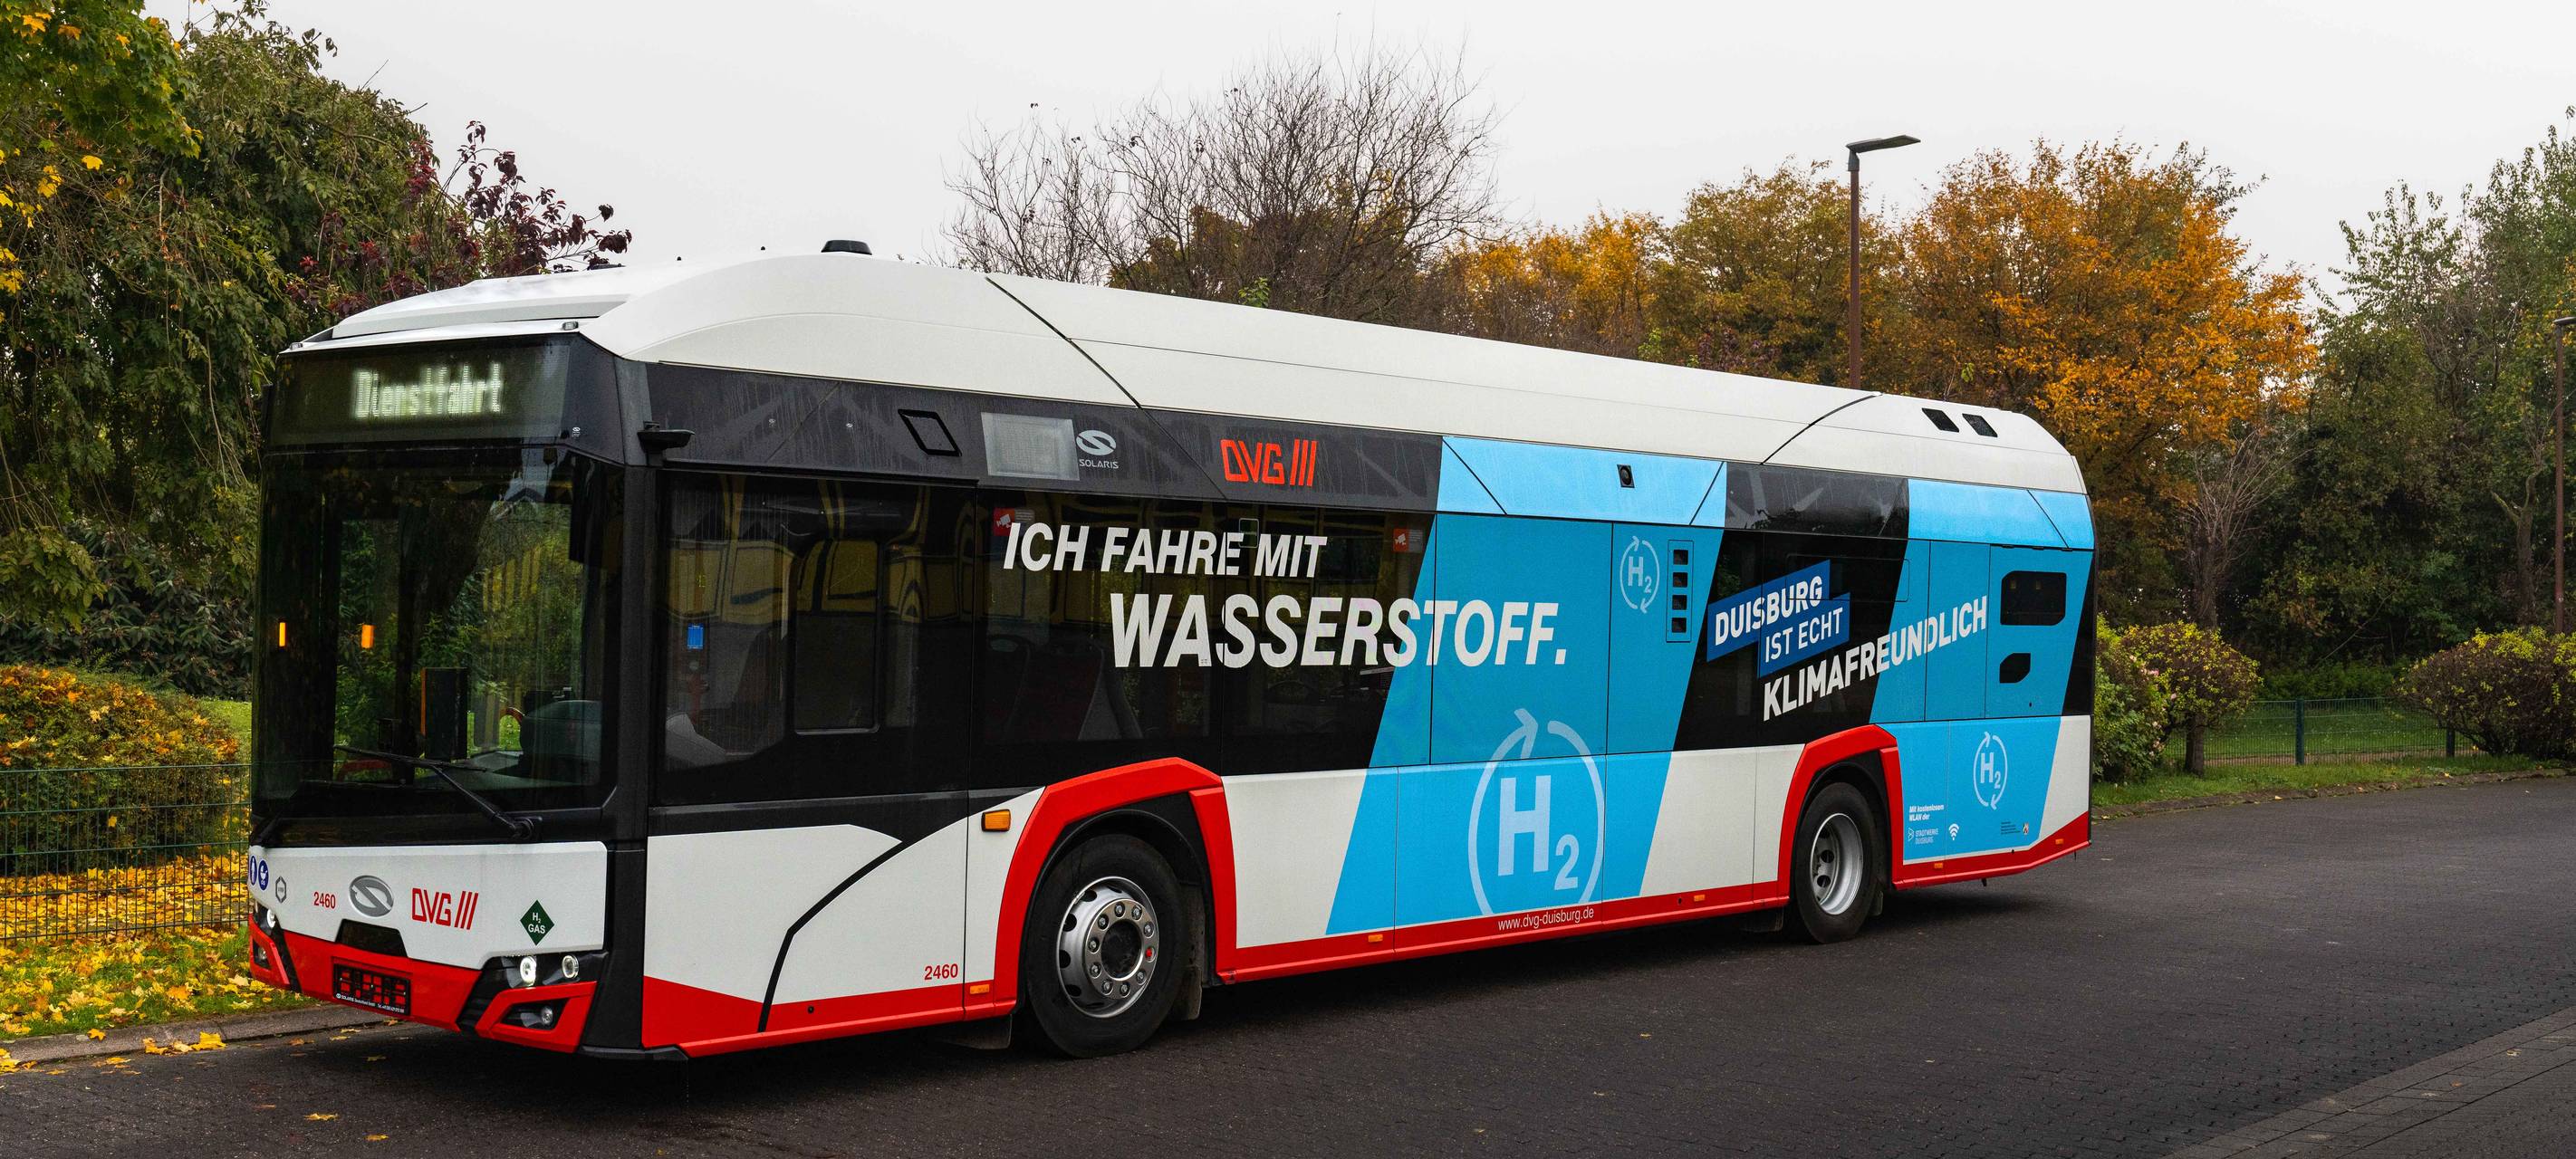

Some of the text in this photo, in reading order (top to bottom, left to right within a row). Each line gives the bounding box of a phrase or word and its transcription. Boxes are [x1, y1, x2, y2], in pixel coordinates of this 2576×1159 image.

[353, 362, 503, 418] Dienstfahrt
[1079, 459, 1119, 469] SOLARIS
[1003, 522, 1328, 579] ICH FAHRE MIT
[1110, 593, 1567, 668] WASSERSTOFF.
[1715, 575, 1822, 646] DUISBURG
[1765, 607, 1843, 663] IST ECHT
[1764, 595, 1988, 722] KLIMAFREUNDLICH
[313, 891, 336, 909] 2460
[1498, 906, 1595, 931] www.dvg-duisburg.de
[528, 923, 545, 934] GAS
[924, 963, 958, 981] 2460
